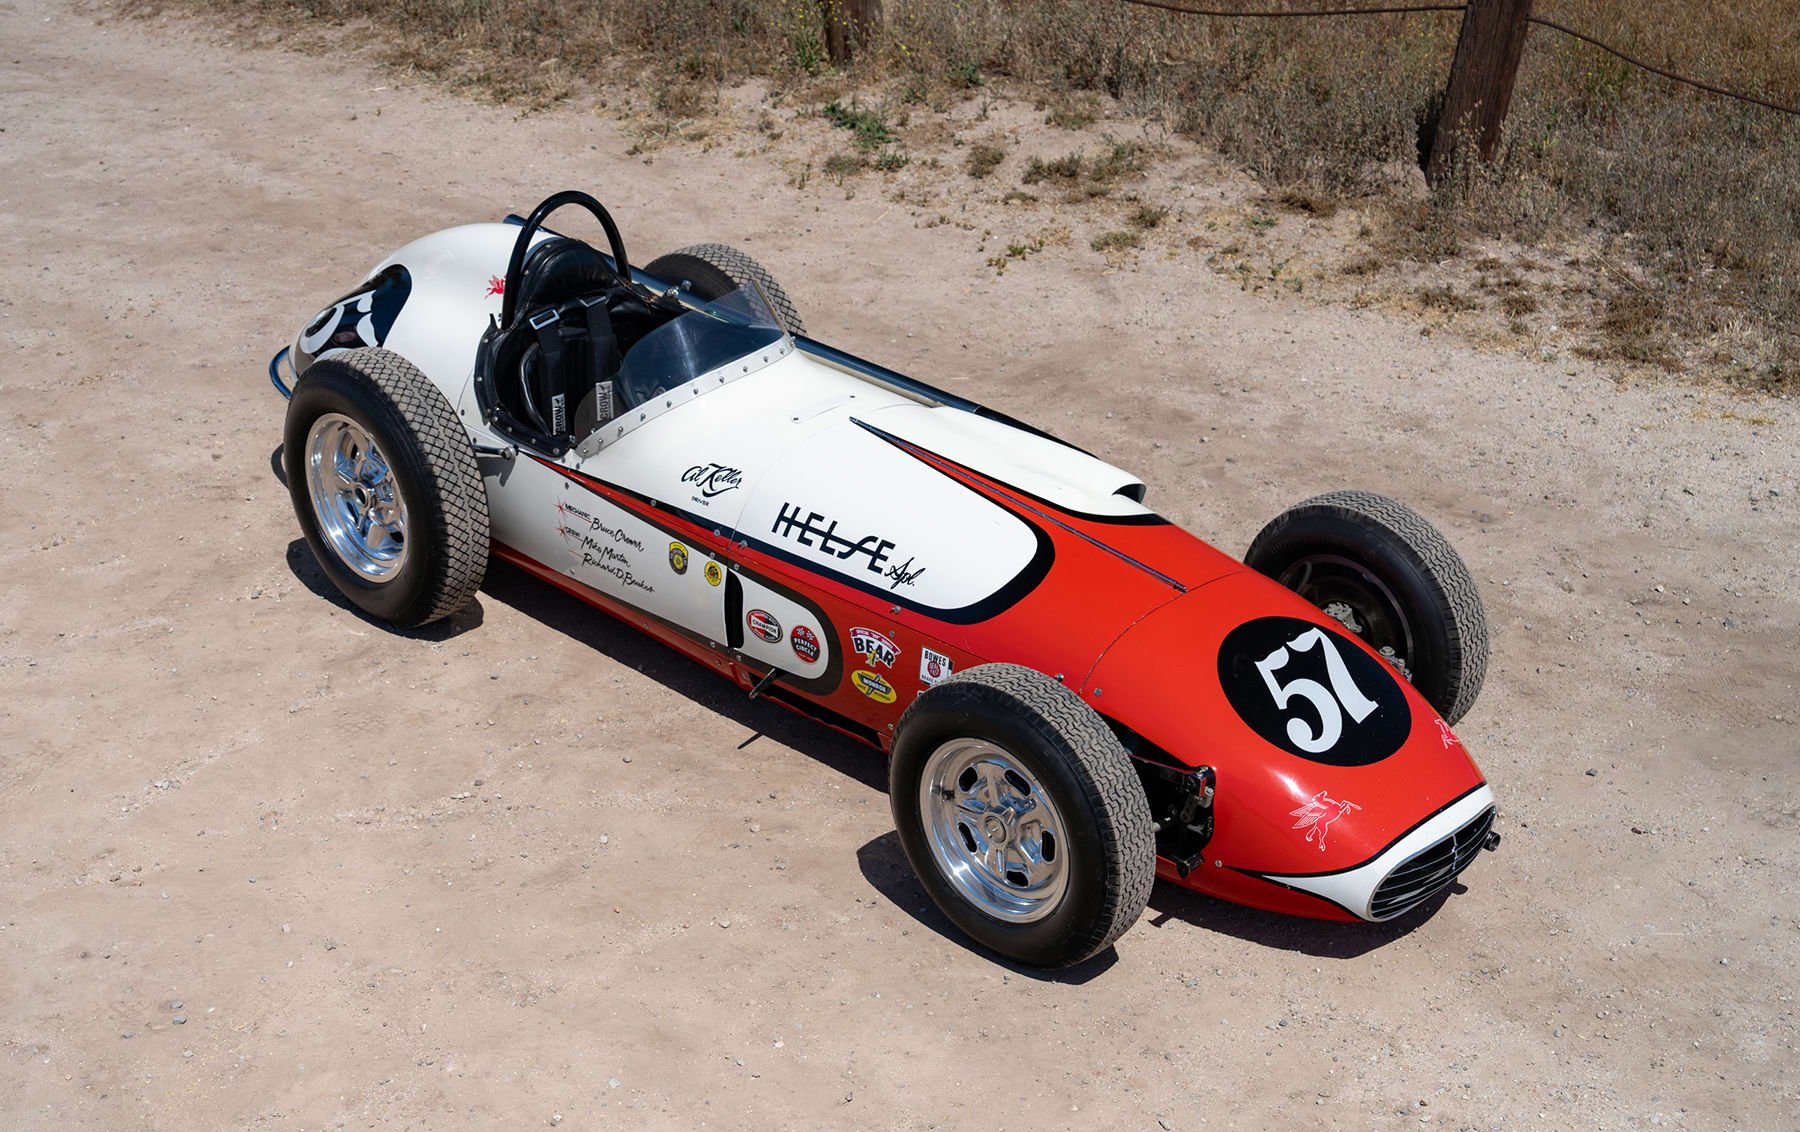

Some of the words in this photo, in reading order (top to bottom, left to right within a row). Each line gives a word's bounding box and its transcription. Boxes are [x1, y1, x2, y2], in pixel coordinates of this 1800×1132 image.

[599, 392, 609, 419] CROW
[554, 406, 564, 433] CROW
[681, 465, 709, 483] Al
[695, 463, 742, 497] Keller
[691, 496, 709, 506] DRIVER
[771, 502, 896, 574] HELSE
[752, 618, 777, 634] CHAMPION
[794, 637, 817, 651] PERFECT
[795, 644, 815, 657] CIRCLE
[854, 637, 895, 667] BEAR
[924, 650, 947, 666] BOWES
[863, 677, 887, 693] MONROE
[1254, 627, 1379, 753] 57
